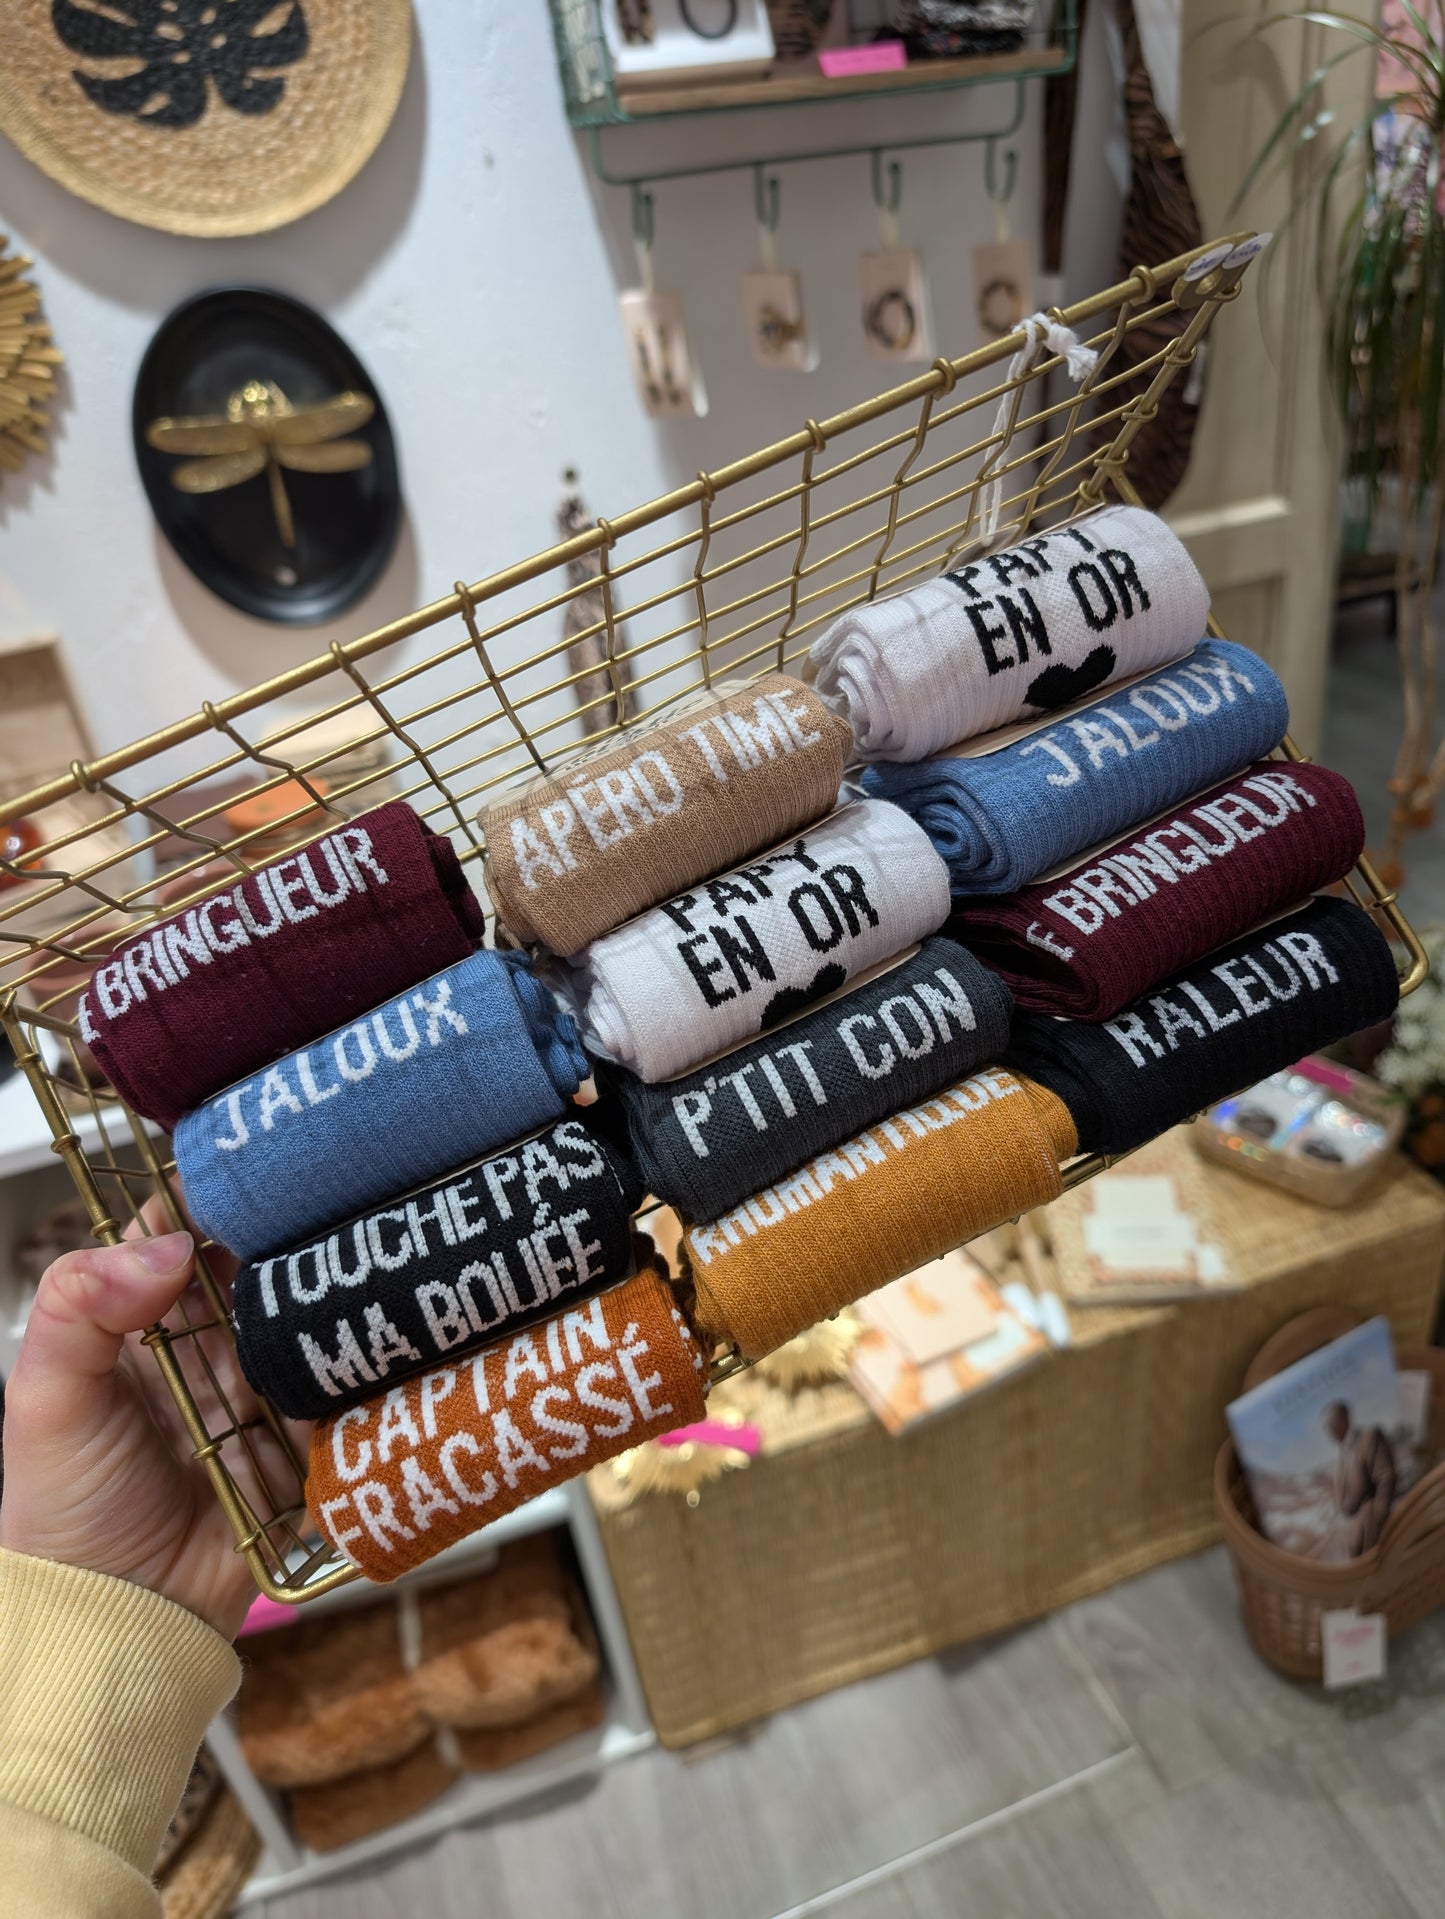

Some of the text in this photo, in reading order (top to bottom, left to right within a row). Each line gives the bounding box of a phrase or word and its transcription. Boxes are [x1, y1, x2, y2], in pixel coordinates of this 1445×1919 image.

[964, 549, 1151, 677] EN OR
[509, 689, 822, 891] APÉRO TIME
[1020, 655, 1255, 788] JALOUX
[95, 827, 389, 1020] BRINGUEUR
[677, 864, 880, 1009] EN OR
[1043, 772, 1317, 936] BRINGUEUR
[213, 979, 469, 1151] JALOUX
[672, 968, 977, 1159] P'TIT CON
[251, 1121, 605, 1318] TOUCHE PAS
[299, 1202, 605, 1397] MA BOUÉE
[319, 1322, 673, 1569] FRACASSÉ
[333, 1296, 612, 1483] CAPTAIN
